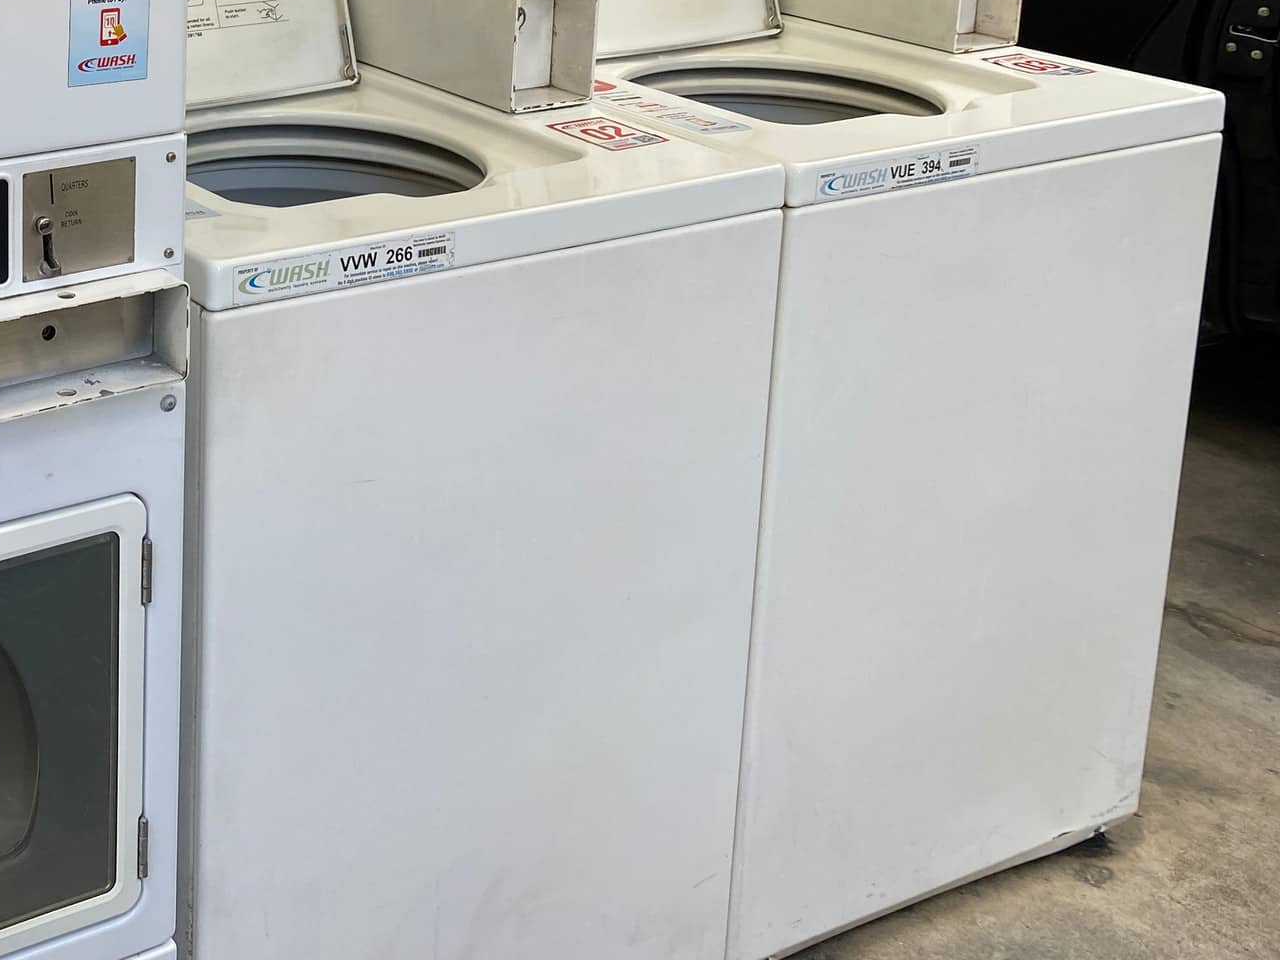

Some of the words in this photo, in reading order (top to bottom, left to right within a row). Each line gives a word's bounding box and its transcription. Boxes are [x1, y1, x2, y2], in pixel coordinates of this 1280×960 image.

[97, 54, 136, 68] WASH
[579, 125, 637, 141] 02
[890, 163, 916, 180] VUE
[921, 159, 942, 175] 394
[61, 179, 89, 192] QUARTERS
[841, 167, 889, 189] WASH
[64, 210, 79, 218] COIN
[61, 219, 83, 228] RETURN
[340, 251, 378, 272] VVW
[386, 245, 413, 265] 266
[269, 259, 330, 286] WASH
